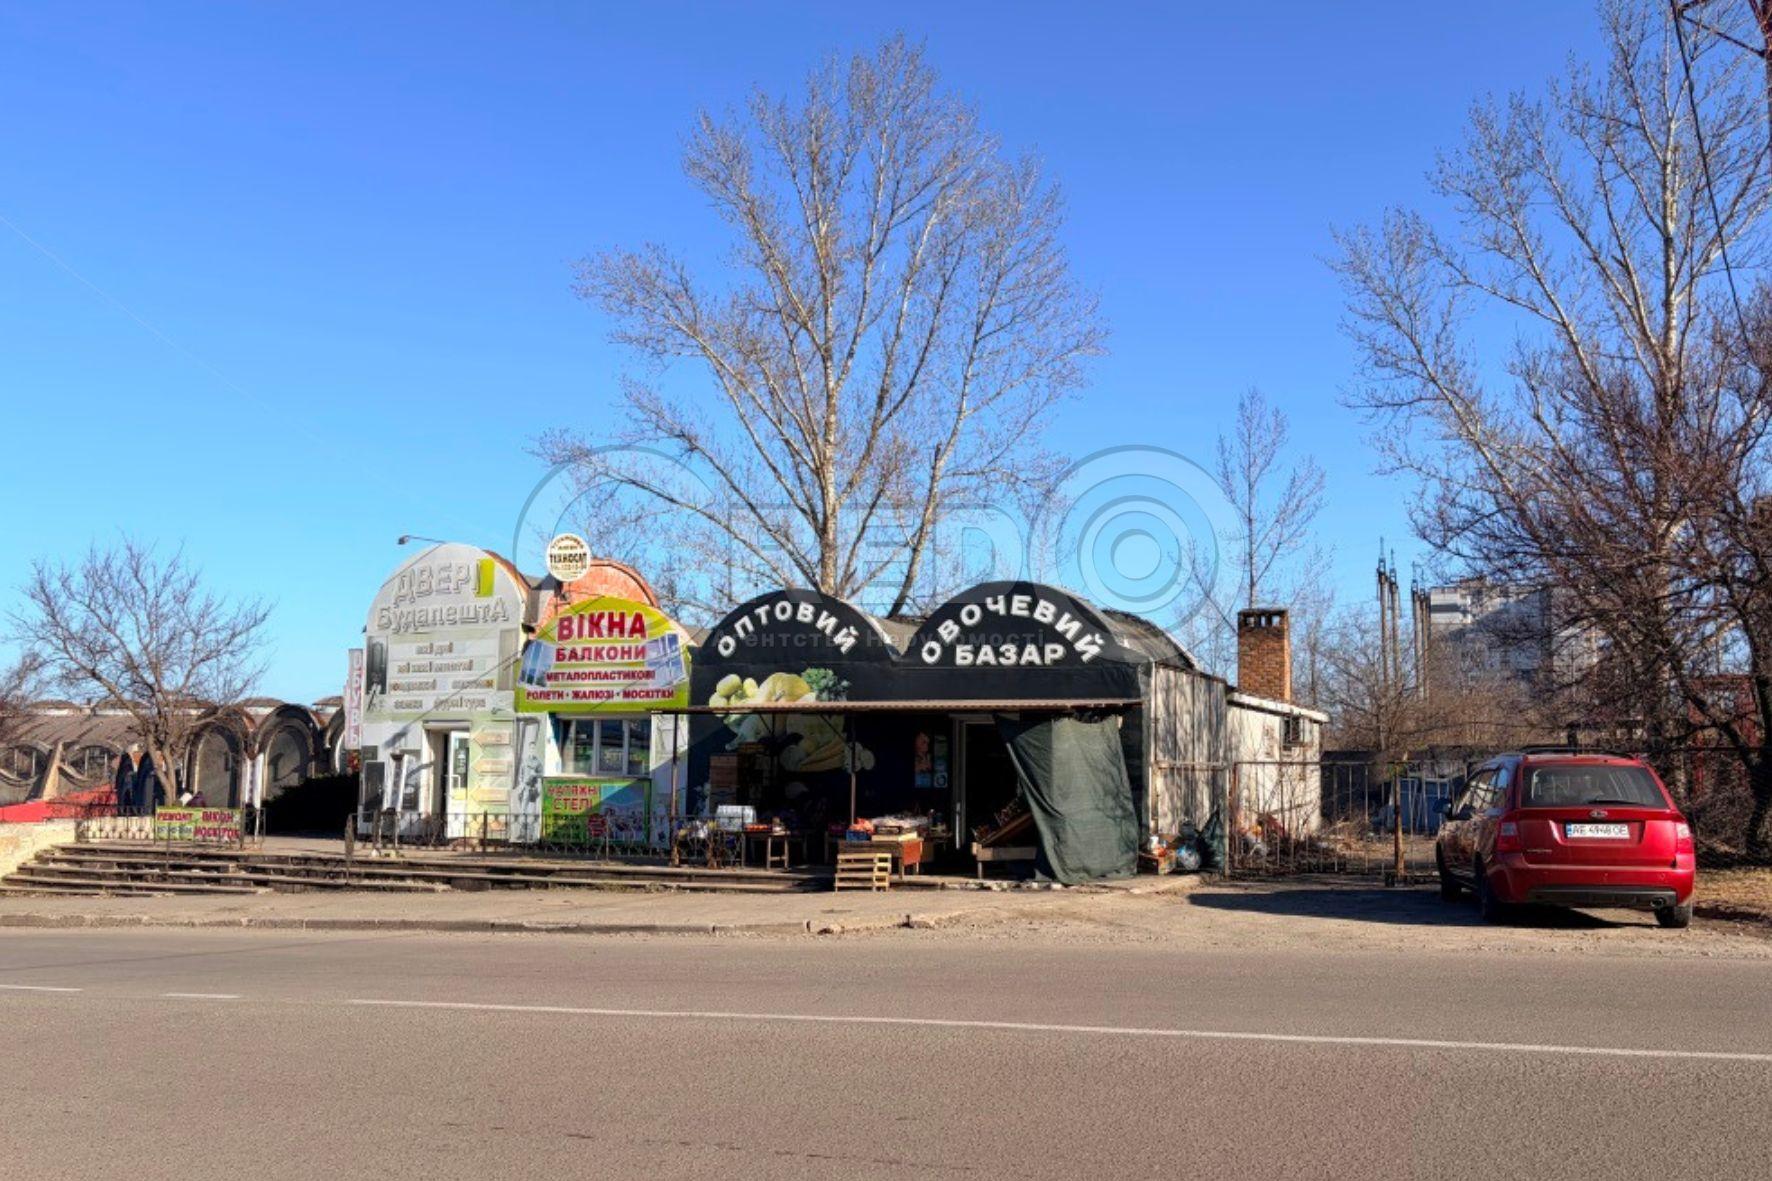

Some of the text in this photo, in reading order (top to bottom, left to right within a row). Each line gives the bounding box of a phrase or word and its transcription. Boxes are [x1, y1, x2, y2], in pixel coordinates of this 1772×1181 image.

[556, 611, 647, 642] ВІКНА
[717, 600, 859, 658] ОПТОВИЙ
[920, 594, 1105, 664] ОВОЧЕВИЙ
[555, 645, 647, 663] БАЛКОНИ
[955, 643, 1066, 665] БАЗАР
[546, 670, 656, 682] МЕТАЛОПЛАСТИКОВІ
